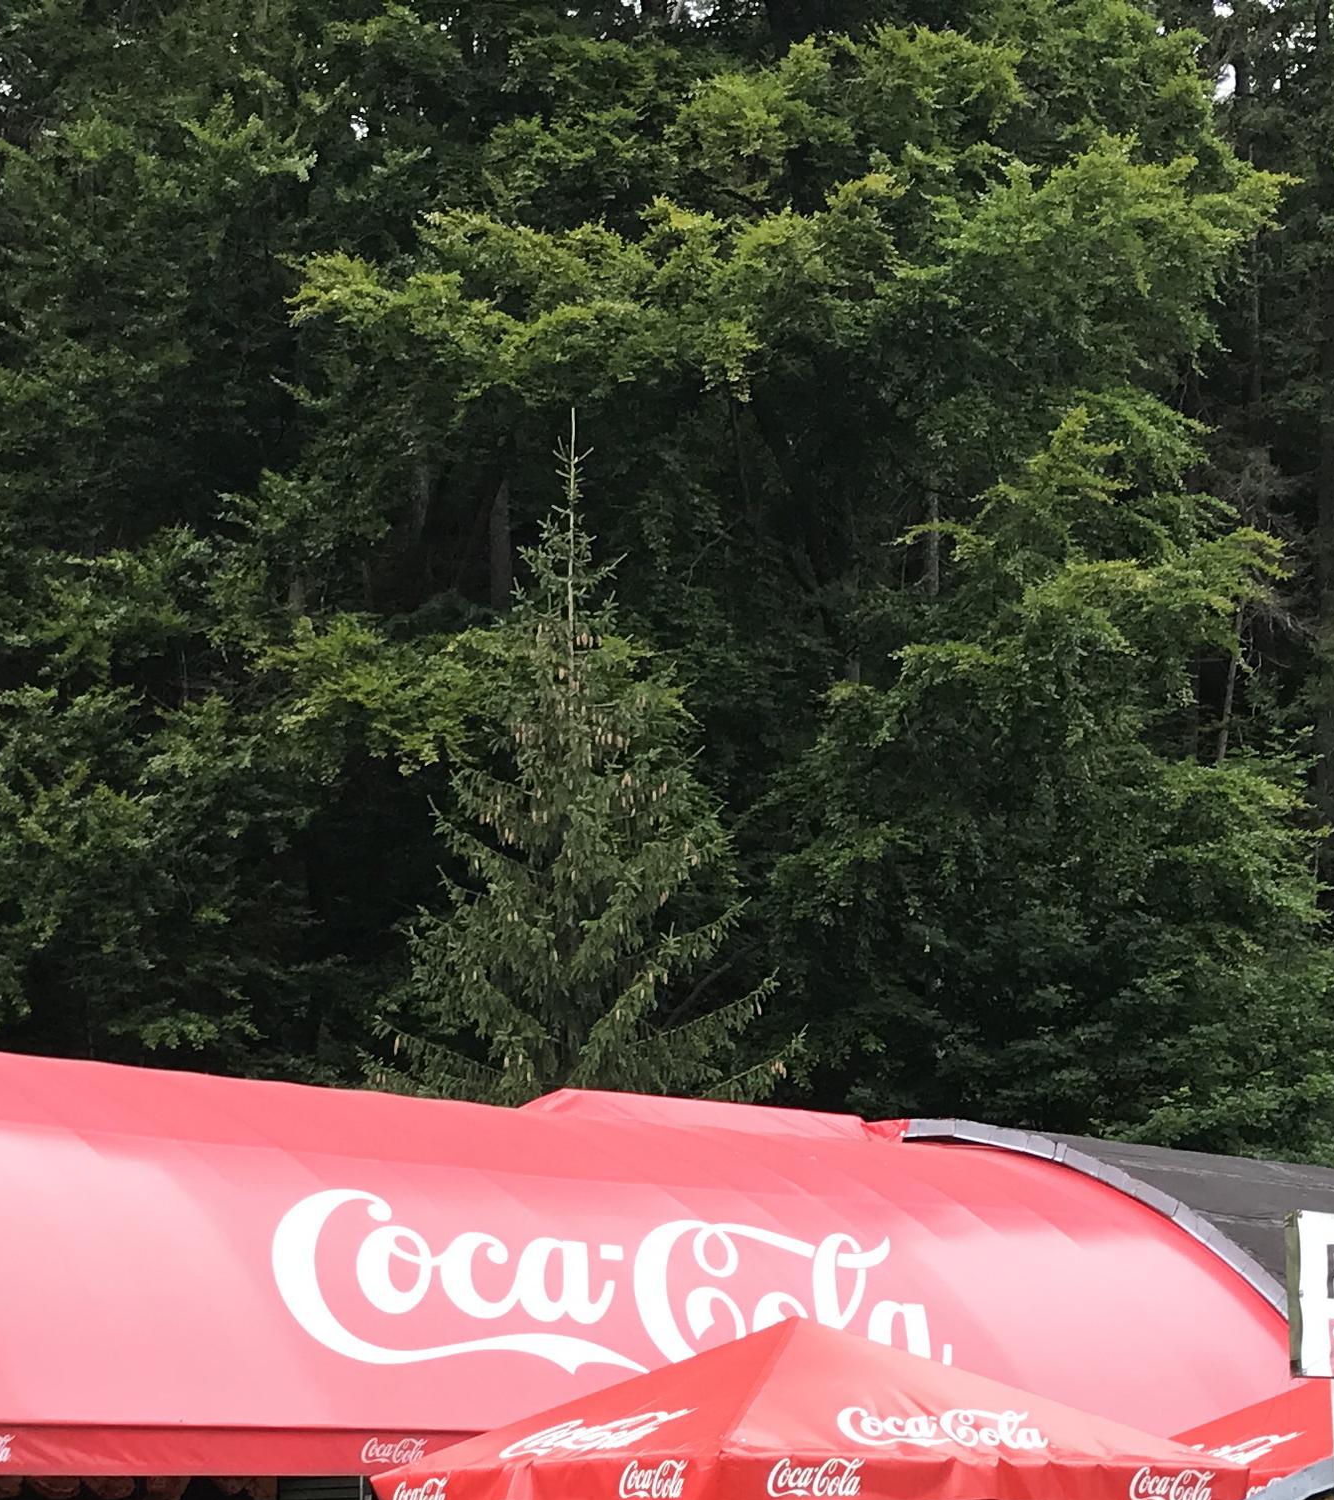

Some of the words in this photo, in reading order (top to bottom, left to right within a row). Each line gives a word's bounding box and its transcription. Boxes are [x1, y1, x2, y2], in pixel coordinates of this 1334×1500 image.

[836, 1406, 1057, 1451] Coca-Cola
[361, 1437, 429, 1465] Coca-Cola
[619, 1459, 689, 1499] Coca-Cola
[766, 1456, 868, 1498] Coca-Cola
